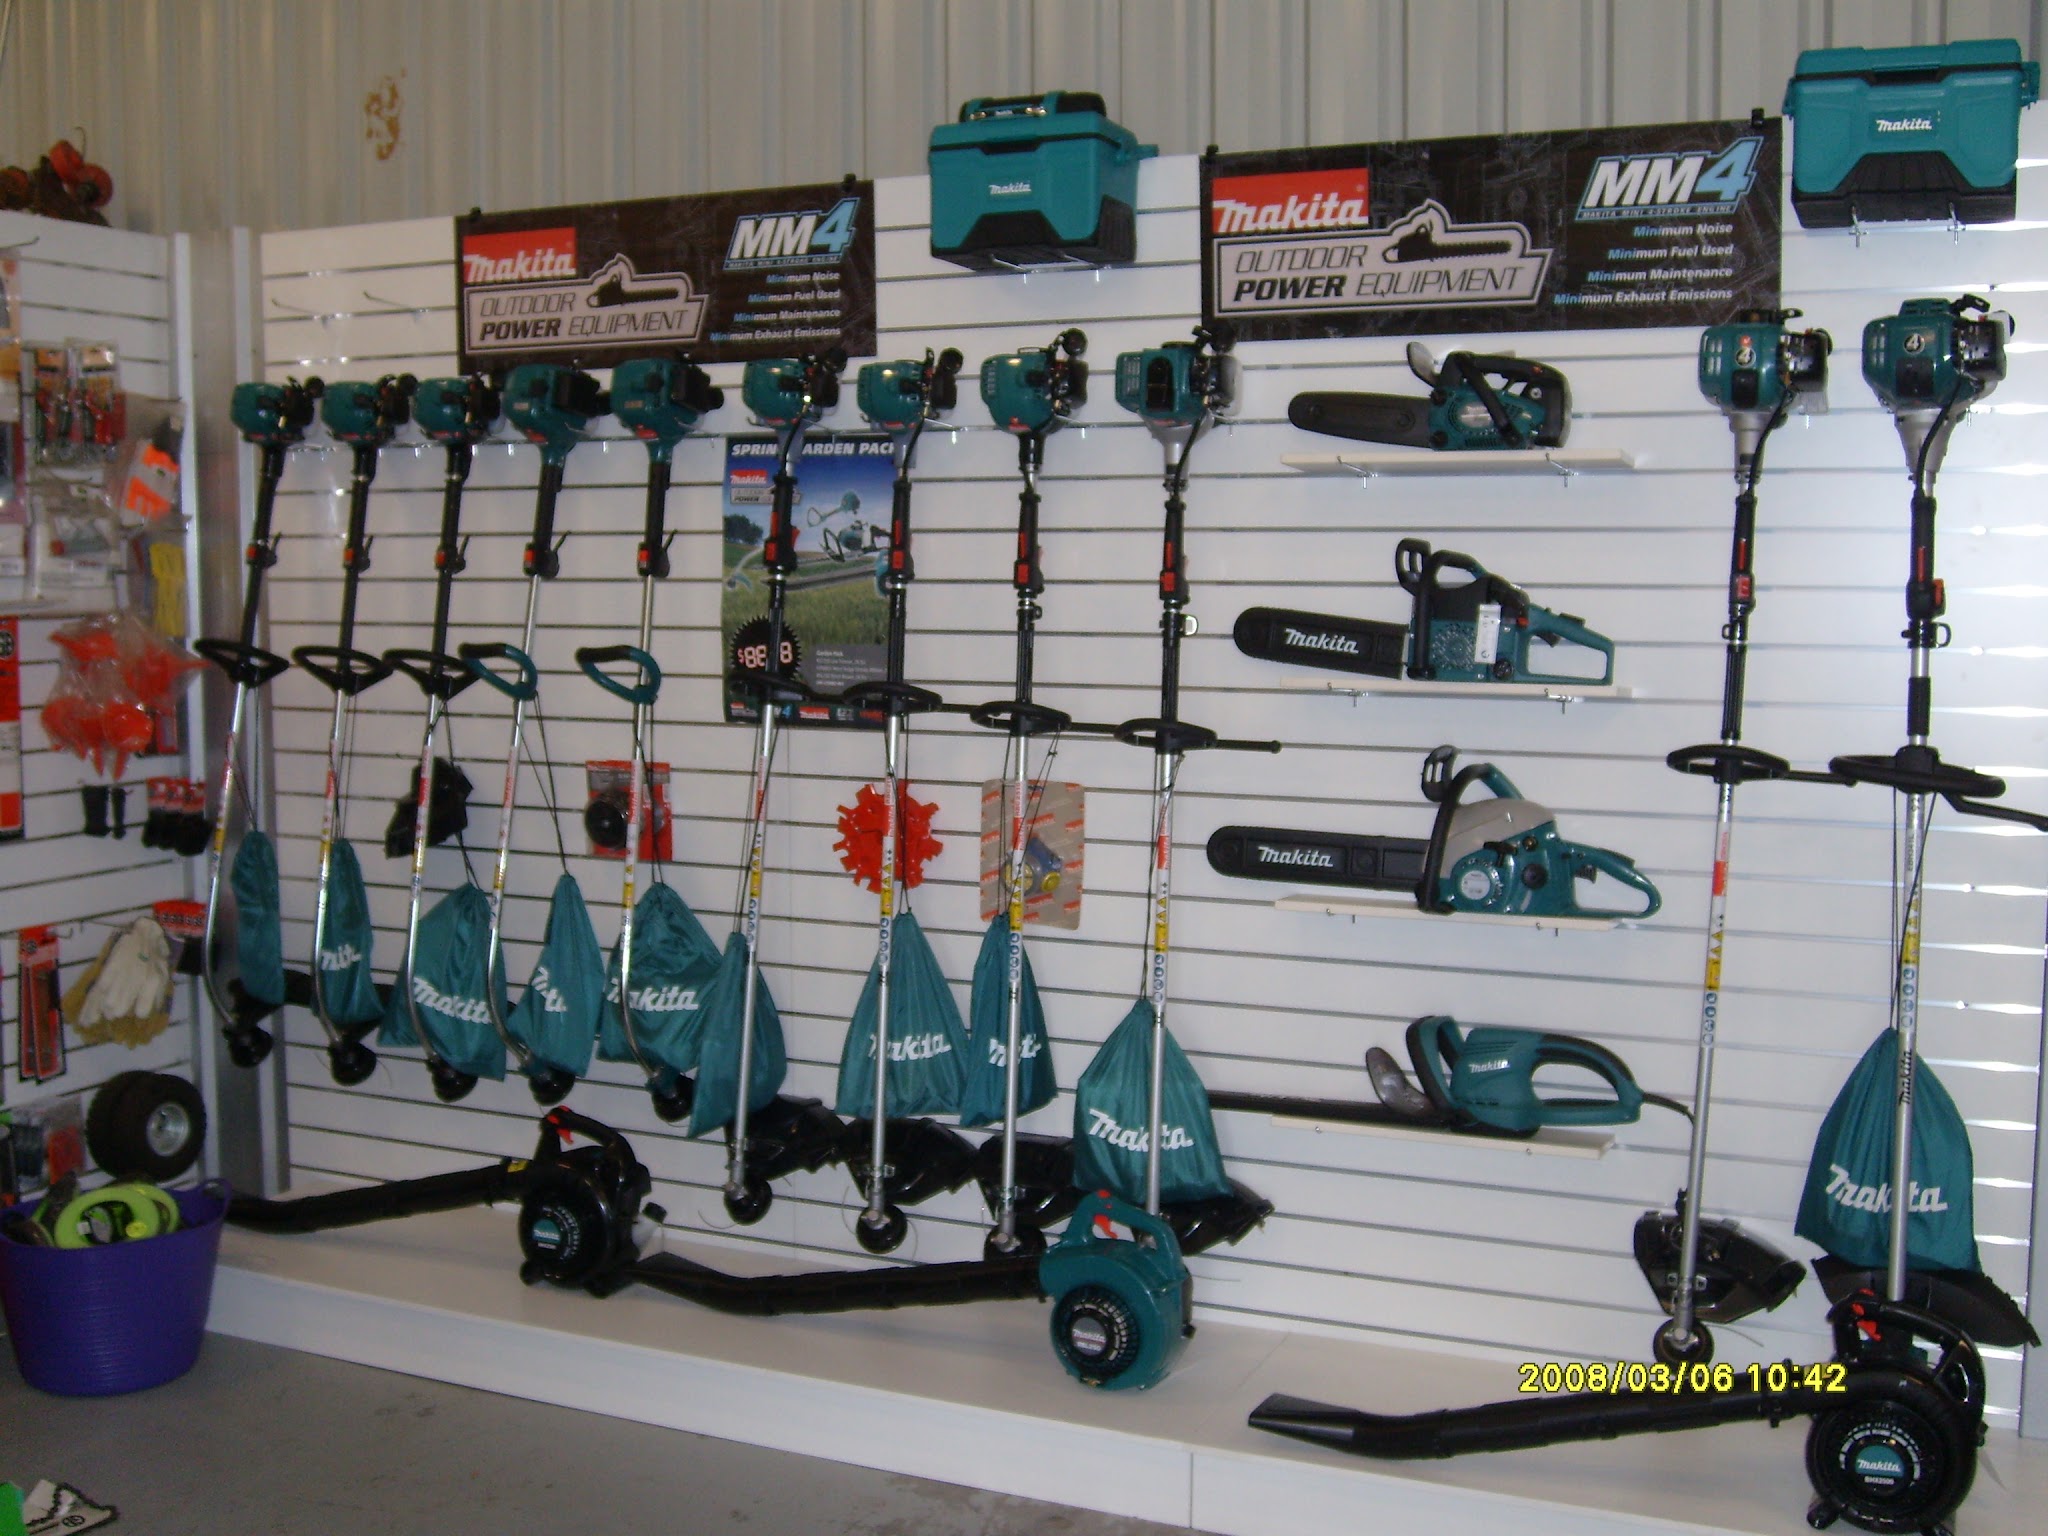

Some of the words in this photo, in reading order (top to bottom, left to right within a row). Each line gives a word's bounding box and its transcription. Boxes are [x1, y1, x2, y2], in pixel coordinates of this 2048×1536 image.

[1876, 118, 1932, 132] Makita
[1585, 141, 1757, 207] MM4
[988, 182, 1031, 194] Makita
[1697, 205, 1731, 213] ENGINE
[729, 200, 857, 260] MM4
[1633, 226, 1693, 237] Minimum
[1696, 223, 1733, 234] Noise
[1236, 245, 1368, 274] OUTDOOR
[1608, 249, 1667, 260] Minimum
[1670, 245, 1699, 257] Fuel
[1701, 244, 1734, 256] Used
[766, 273, 810, 283] Minimum
[813, 271, 840, 281] Noise
[1588, 271, 1646, 282] Minimum
[1650, 268, 1733, 280] Maintenance
[1234, 275, 1347, 302] POWER
[1356, 267, 1525, 298] EQUIPMENT
[748, 293, 792, 303] Minimum
[794, 291, 815, 300] Fuel
[817, 290, 840, 299] Used
[1554, 293, 1612, 305] Minimum
[1616, 291, 1666, 302] Exhaust
[1669, 289, 1733, 300] Emissions
[480, 292, 577, 317] OUTDOOR
[733, 312, 777, 322] Minimum
[779, 309, 841, 320] Maintenance
[479, 317, 562, 341] POWER
[568, 309, 688, 337] EQUIPMENT
[710, 332, 753, 342] Minimum
[755, 329, 792, 339] Exhaust
[794, 327, 841, 338] Emissions
[731, 443, 778, 455] SPRIN
[802, 442, 855, 455] ARDEN
[1283, 627, 1360, 655] Makita
[1257, 845, 1334, 868] Makita
[1468, 1059, 1510, 1073] Makita
[1089, 1108, 1194, 1152] Makta
[1825, 1163, 1949, 1214] Makta
[1857, 1459, 1901, 1472] Makita
